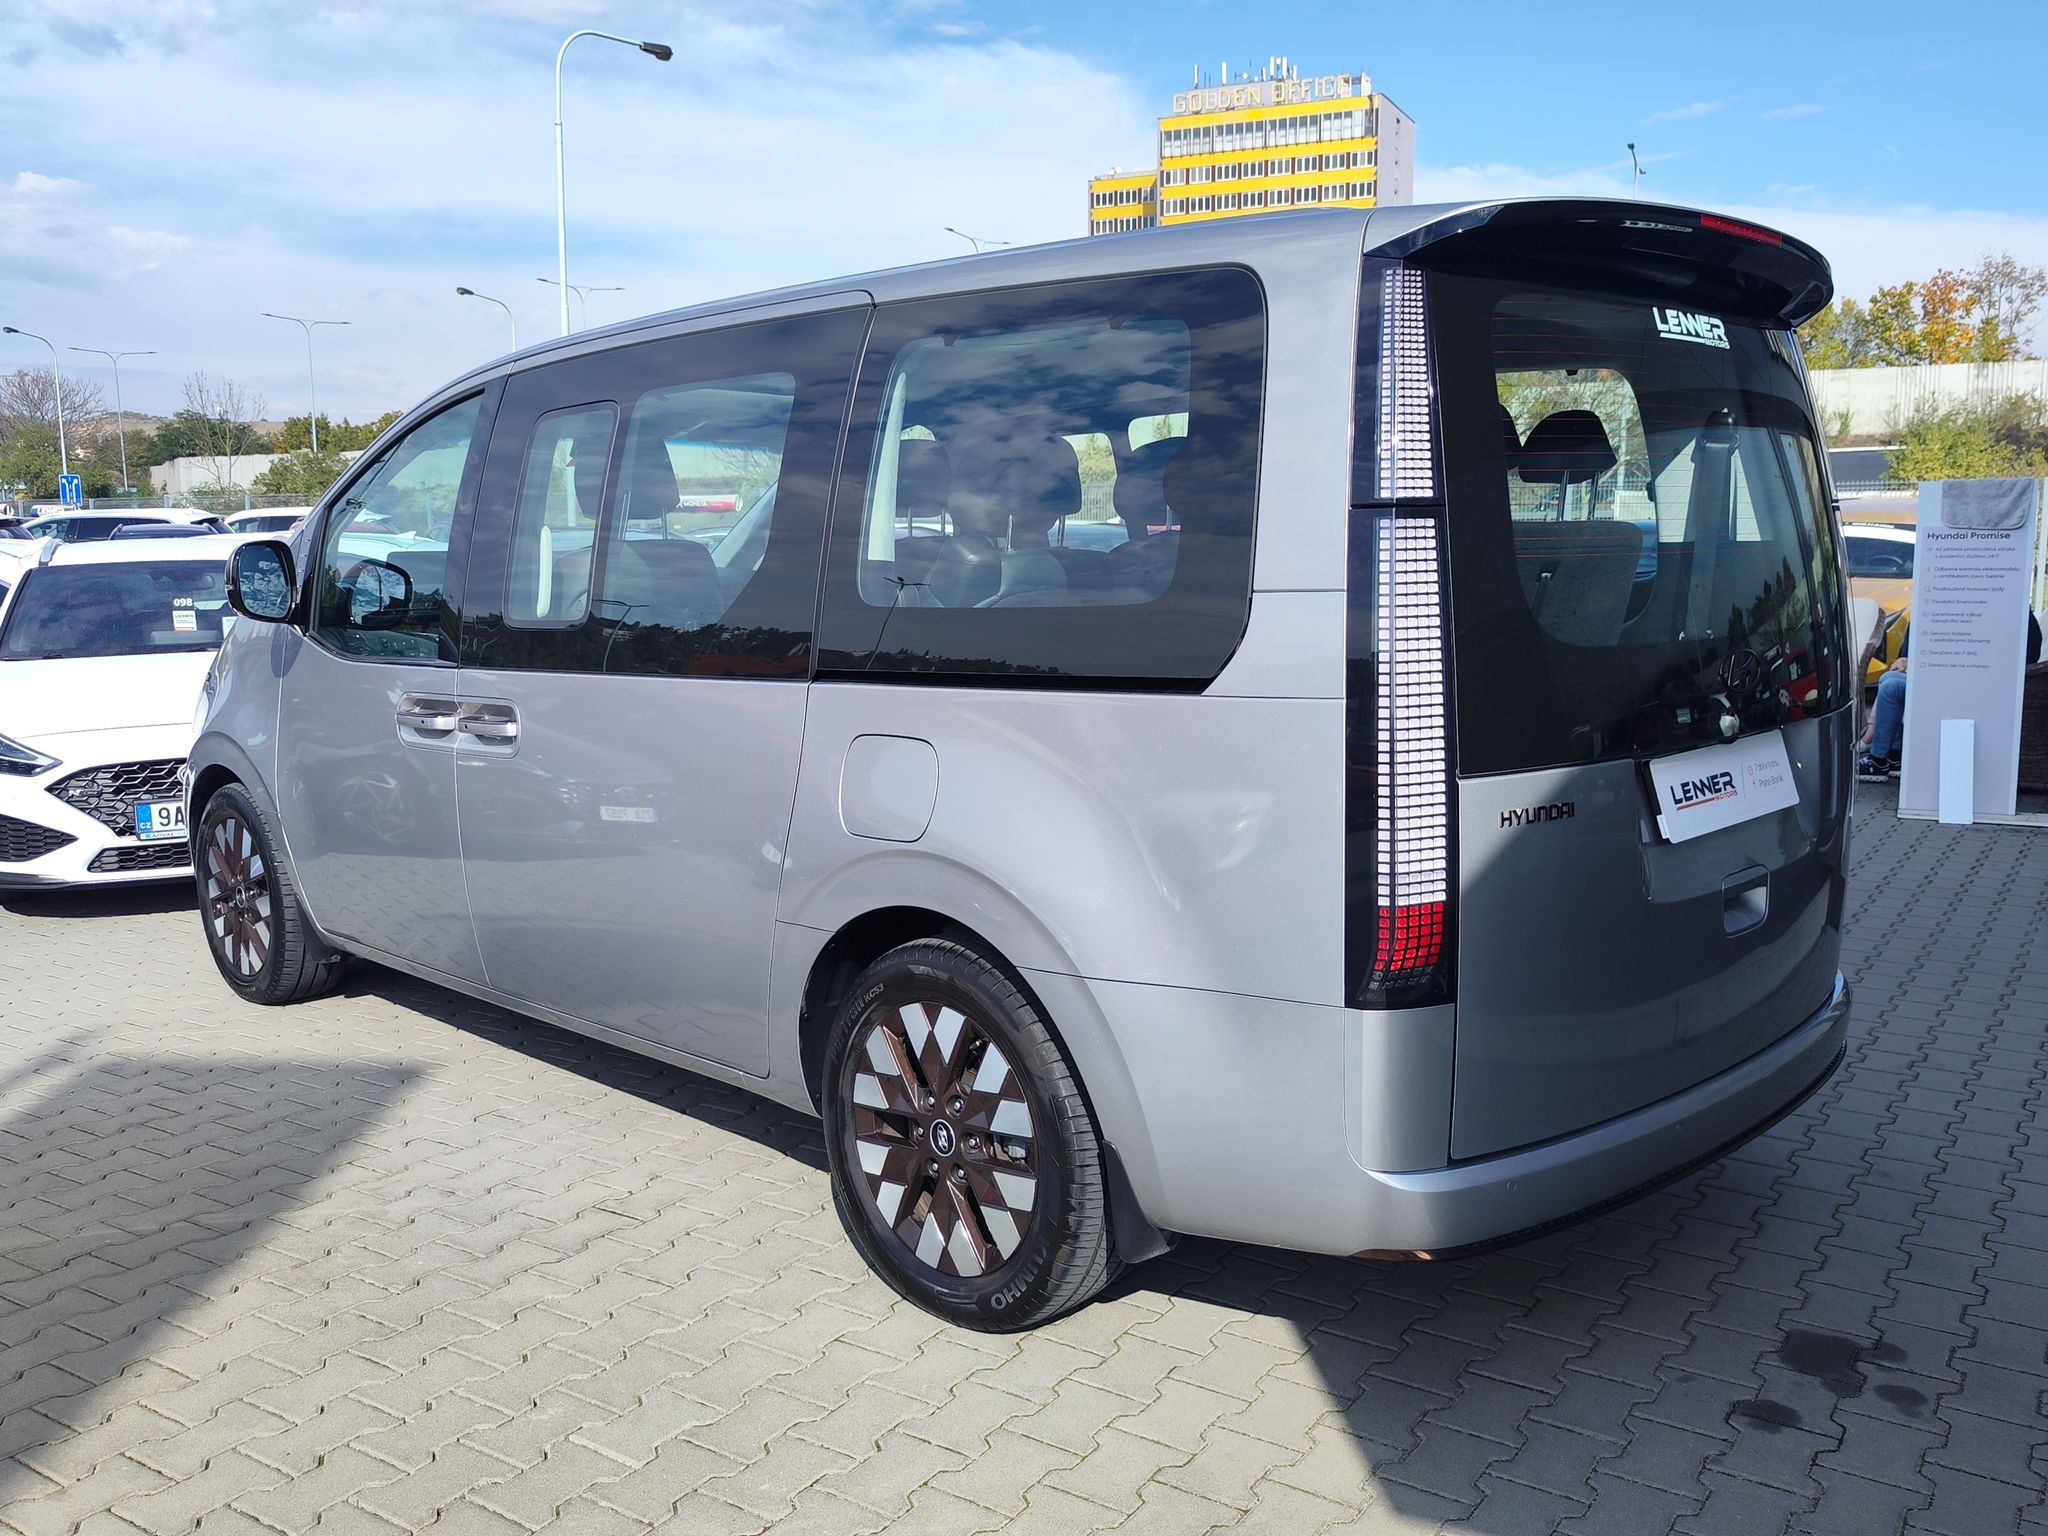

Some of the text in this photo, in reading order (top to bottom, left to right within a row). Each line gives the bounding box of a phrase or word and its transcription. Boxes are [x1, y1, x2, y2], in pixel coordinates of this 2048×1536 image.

[1172, 84, 1261, 114] GOLDEN
[1652, 306, 1729, 343] LENNER
[1927, 532, 2011, 541] Hyundai Promise
[173, 597, 193, 607] 098
[1670, 771, 1736, 805] LENNER
[1499, 801, 1575, 829] HYUNDAI
